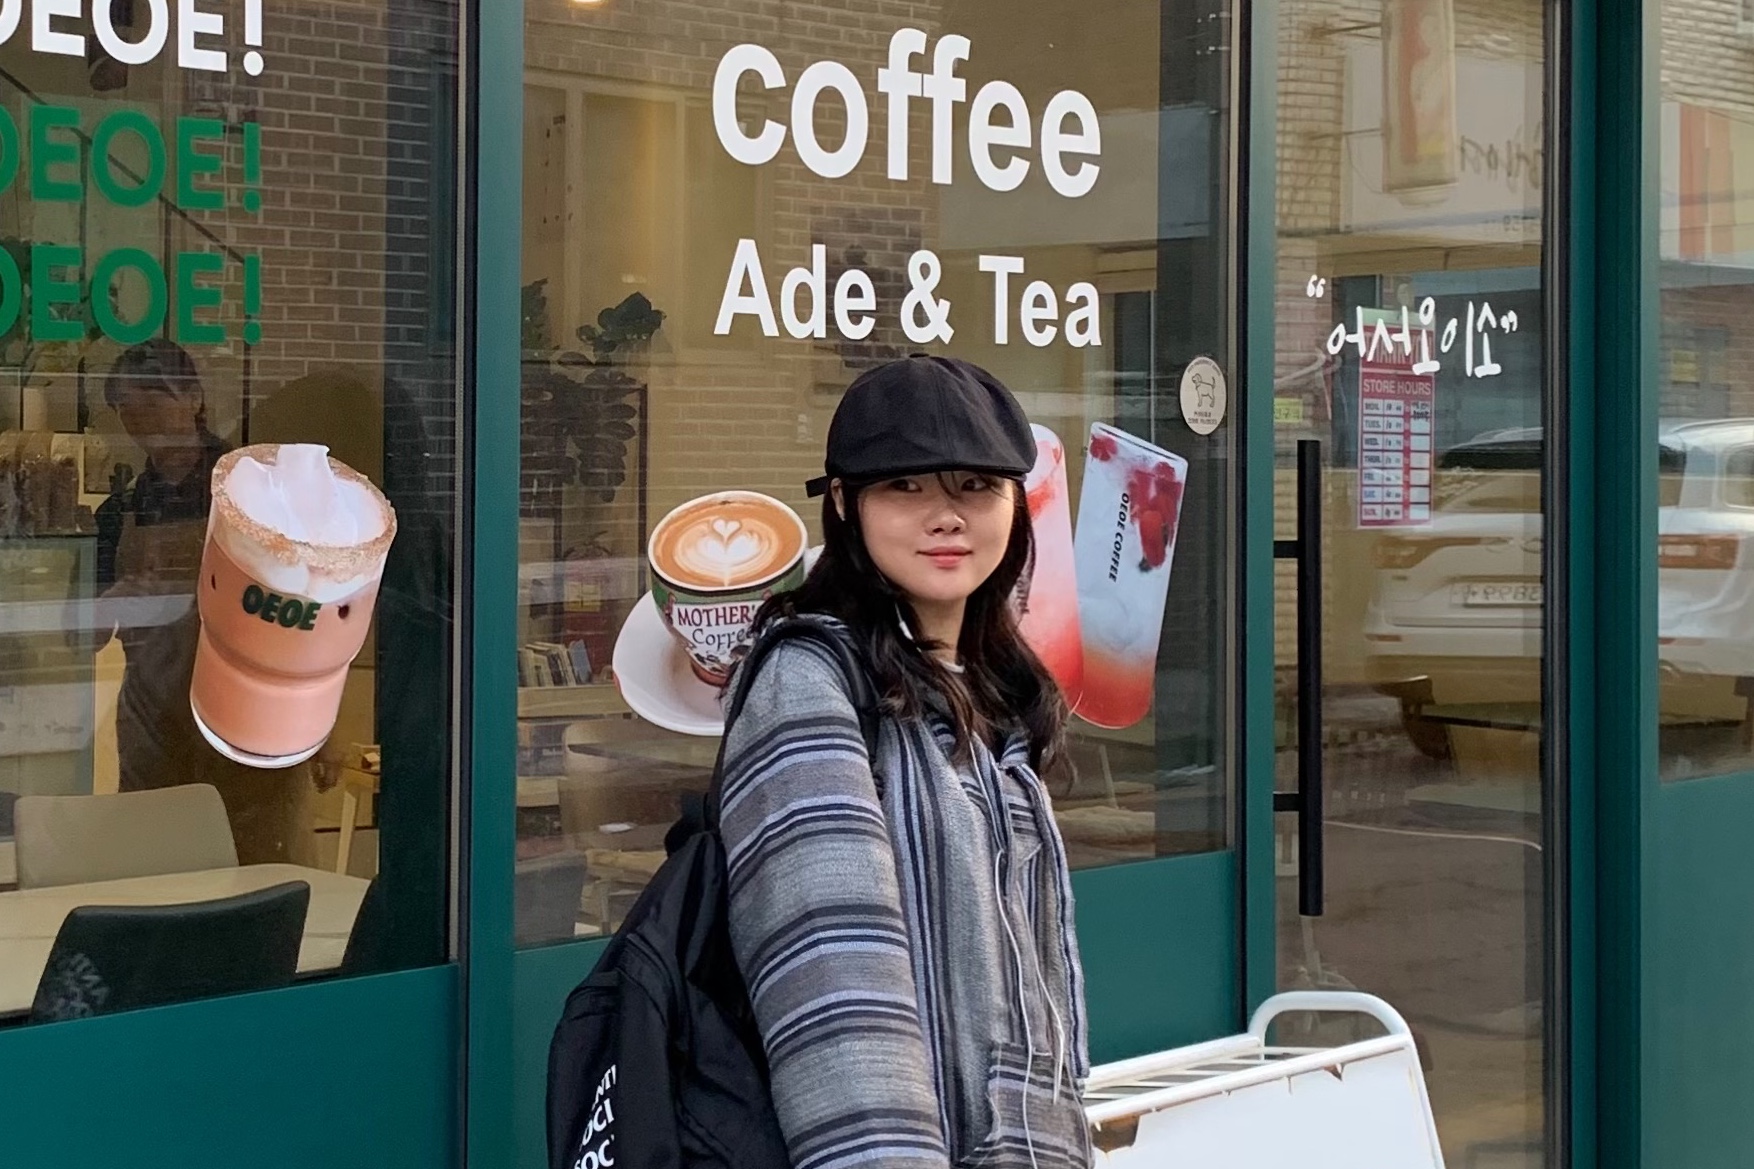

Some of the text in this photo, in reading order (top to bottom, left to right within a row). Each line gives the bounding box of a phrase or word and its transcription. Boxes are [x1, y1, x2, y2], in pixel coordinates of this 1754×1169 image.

[0, 0, 264, 76] EOE!
[0, 104, 261, 213] EOE!
[0, 243, 261, 345] EOE!
[713, 238, 1102, 348] Ade & Tea
[1363, 379, 1431, 395] STORE HOURS
[1108, 492, 1129, 583] OEOE COFFEE
[242, 584, 323, 631] OEOE
[677, 604, 756, 627] MOTHER'
[591, 1064, 616, 1111] NTI
[579, 1098, 615, 1152] OCI
